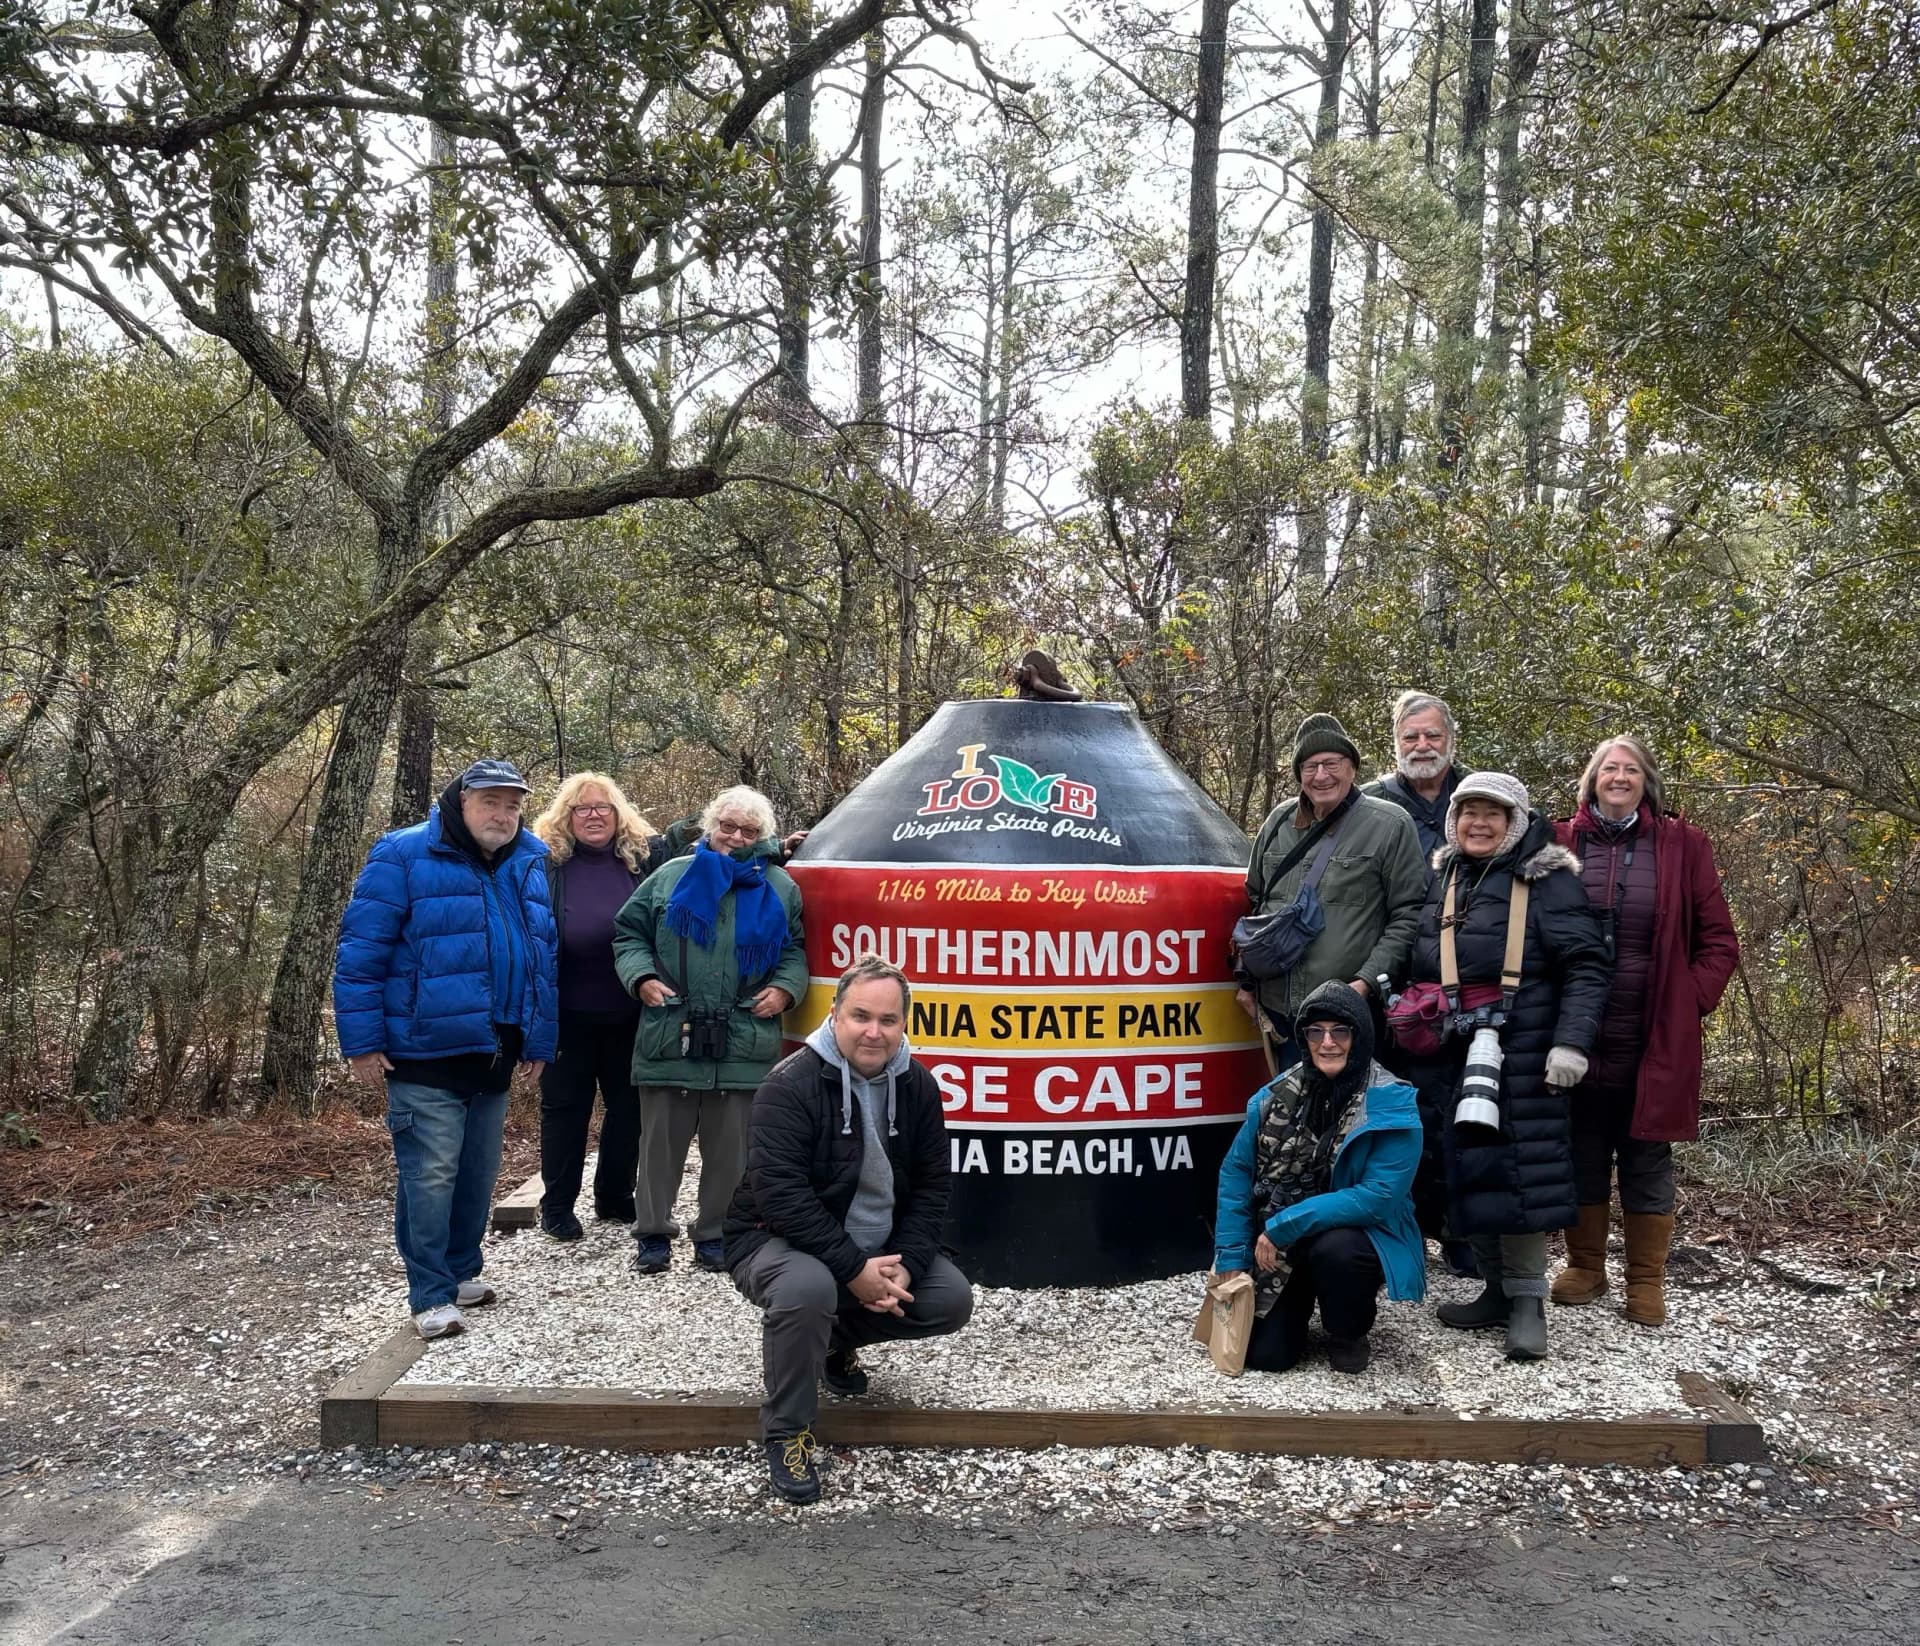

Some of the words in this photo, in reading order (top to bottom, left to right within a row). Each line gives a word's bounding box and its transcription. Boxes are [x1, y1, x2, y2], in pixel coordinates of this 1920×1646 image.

[952, 743, 987, 778] I
[892, 815, 982, 841] Virginia
[986, 812, 1049, 833] State
[1051, 818, 1122, 846] Parks
[878, 879, 926, 902] 1,146
[935, 879, 1002, 902] Miles
[1007, 882, 1032, 903] to
[1037, 879, 1087, 909] Key
[1094, 880, 1149, 905] West
[831, 923, 1205, 976] SOUTHERNMOST
[990, 1004, 1104, 1039] STATE
[1118, 1001, 1203, 1038] PARK
[1034, 1062, 1203, 1114] CAPE
[1003, 1138, 1144, 1177] BEACH,
[1150, 1135, 1194, 1171] VA
